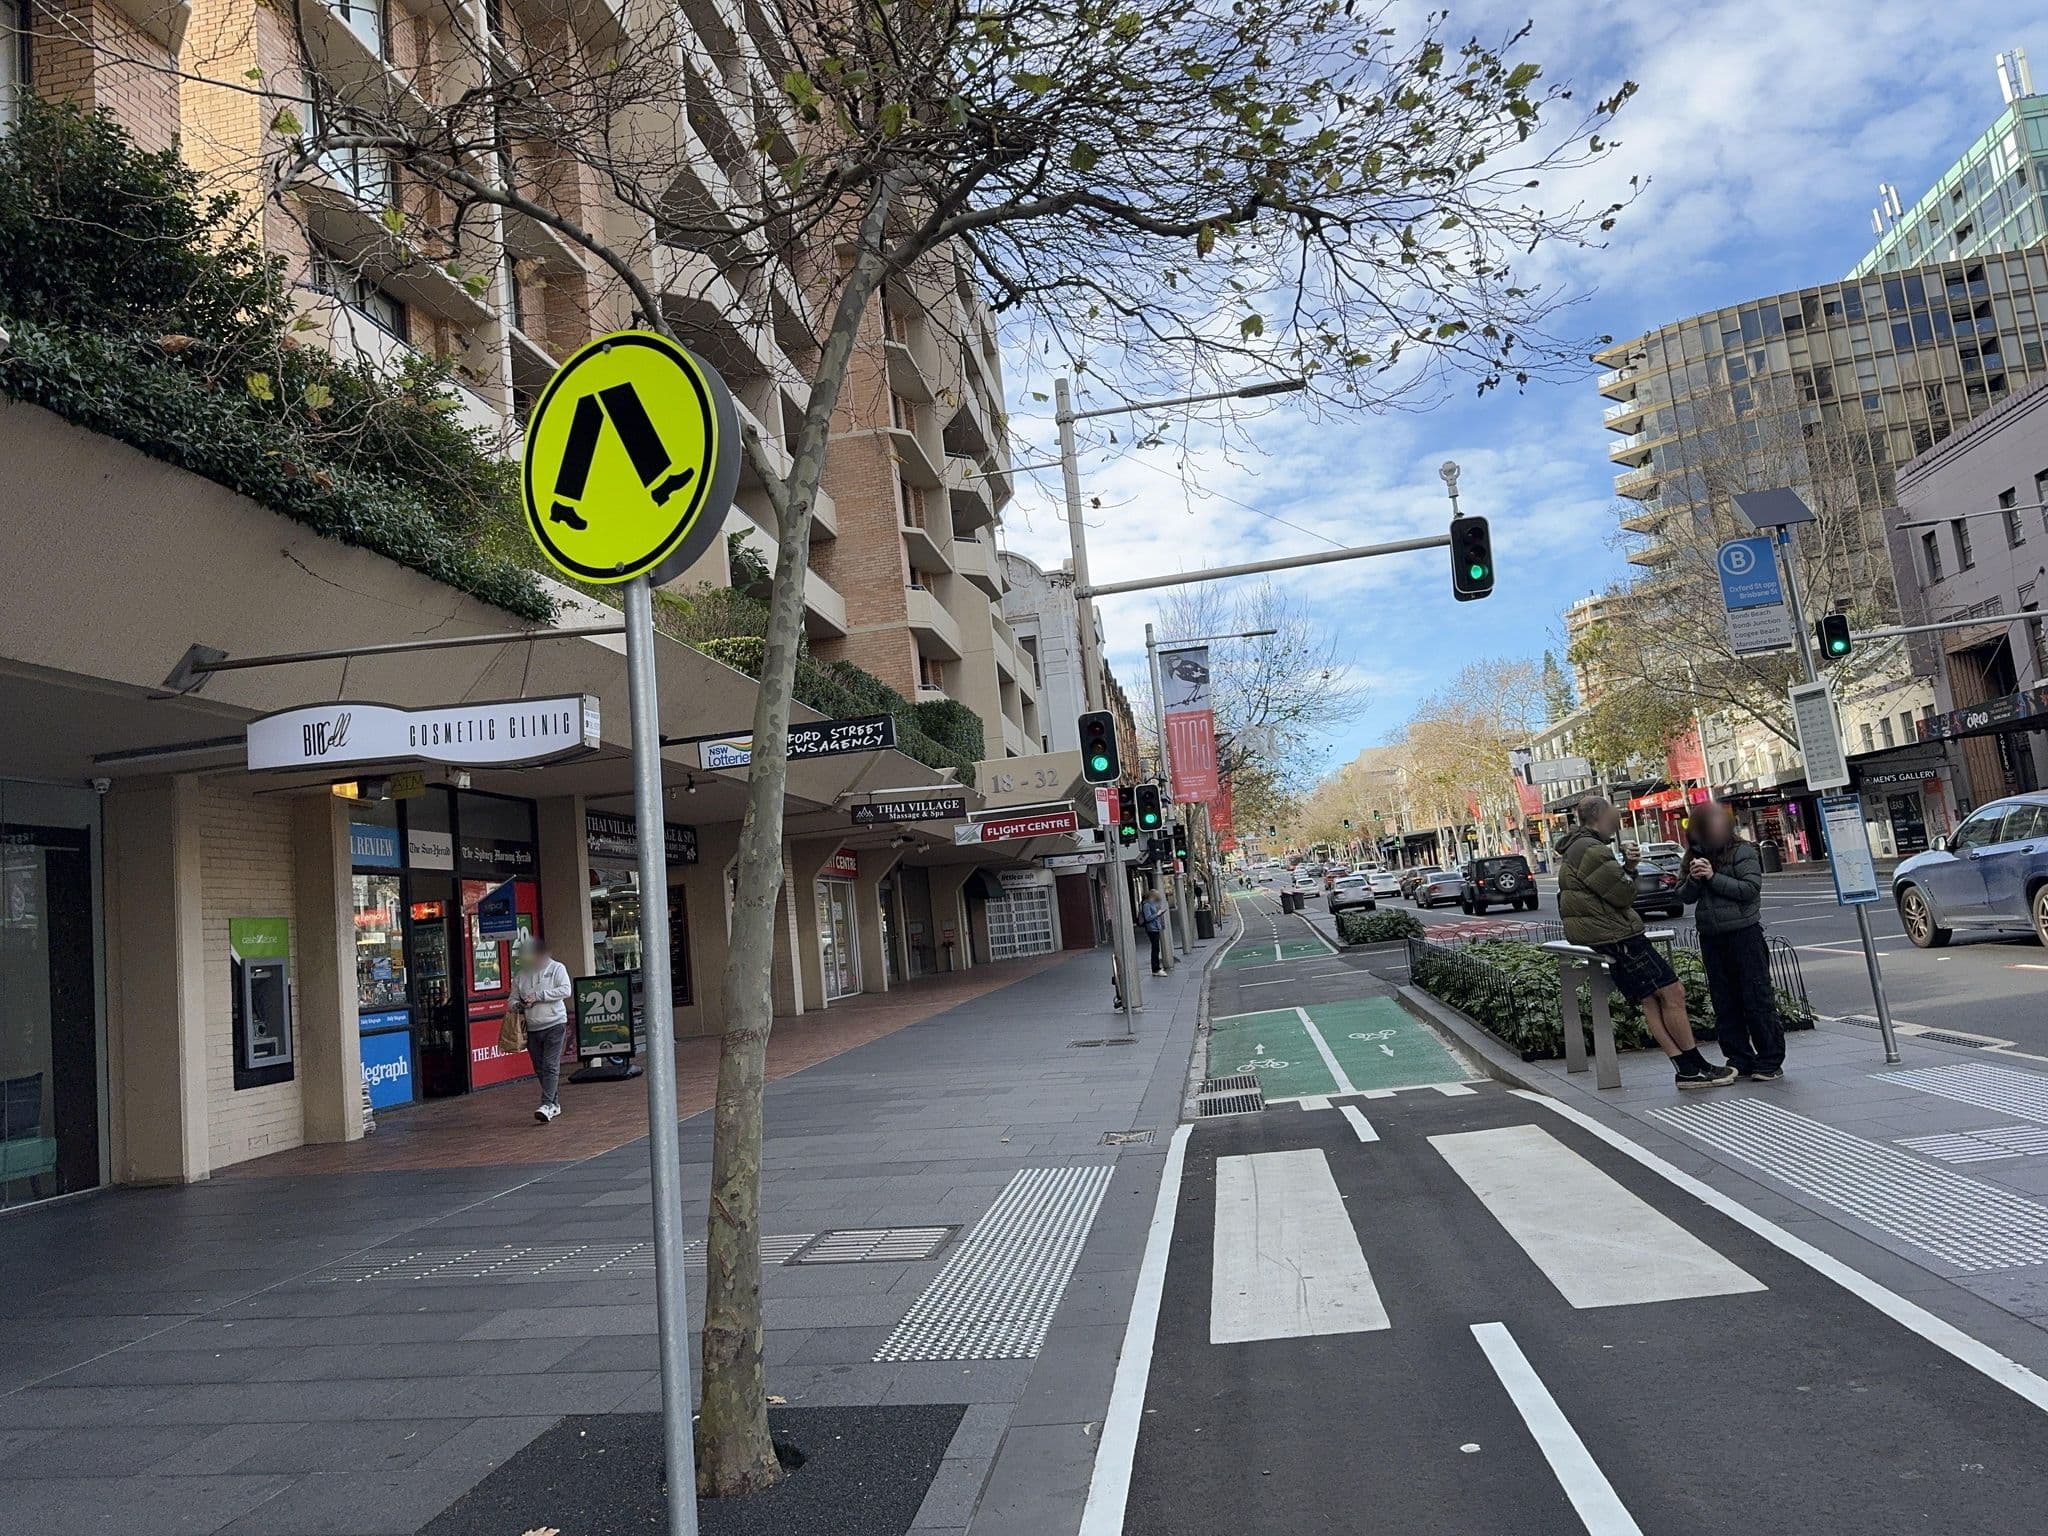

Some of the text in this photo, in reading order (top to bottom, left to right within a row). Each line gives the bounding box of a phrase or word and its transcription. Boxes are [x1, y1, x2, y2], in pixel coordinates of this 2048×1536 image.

[1730, 582, 1753, 593] Oxford
[1763, 581, 1777, 590] opp
[1740, 590, 1770, 599] Brisbane
[1731, 612, 1749, 620] Bondi
[1733, 618, 1781, 629] Bondi Junction
[1735, 627, 1781, 639] Coogee Beach
[1736, 636, 1788, 647] Maroubra Beach
[409, 718, 495, 747] COSMETIC
[509, 712, 570, 739] CLINIC
[788, 722, 884, 744] FORD STREET
[709, 746, 728, 756] NSW
[786, 734, 884, 757] EWSAGENCY
[991, 774, 1014, 793] 18
[1034, 768, 1059, 789] 32
[1872, 770, 1936, 785] MEN'S GALLERY
[877, 800, 960, 814] THAI VILLAGE
[889, 812, 919, 820] Massage
[930, 810, 944, 818] Spa
[587, 817, 607, 832] THAI
[986, 819, 1071, 836] FLIGHT CENTRE
[357, 837, 393, 857] REVIEW
[409, 842, 420, 854] The
[462, 846, 532, 865] The Sydney Morning Herald
[836, 856, 857, 871] CENTRE
[475, 950, 497, 960] MILLION
[579, 989, 623, 1016] $20
[584, 1012, 625, 1025] MILLION
[472, 1047, 490, 1062] THE
[361, 1056, 408, 1086] legraph
